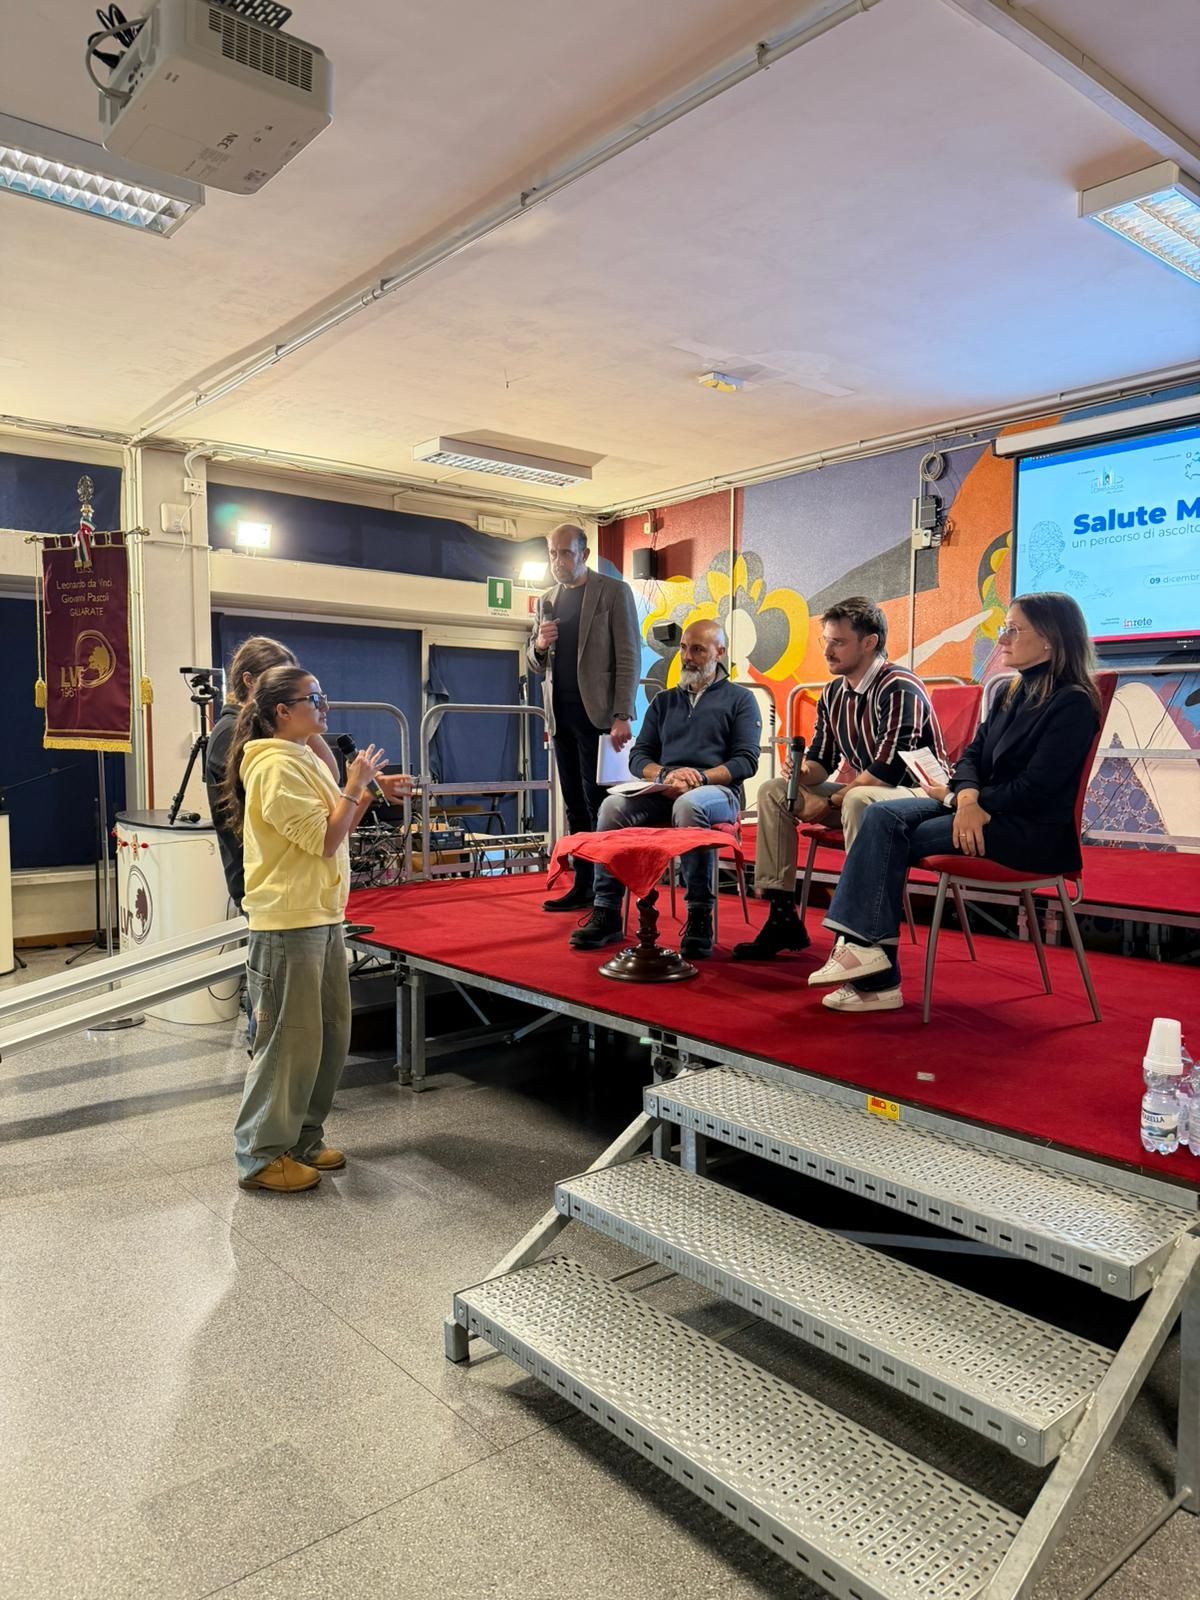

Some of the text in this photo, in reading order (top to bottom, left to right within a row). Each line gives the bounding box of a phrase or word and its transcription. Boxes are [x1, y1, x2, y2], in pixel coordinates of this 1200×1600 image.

[217, 132, 239, 150] NEC
[1073, 506, 1167, 535] Salute
[1071, 539, 1087, 549] un
[1090, 532, 1140, 548] percorso
[1143, 528, 1155, 540] di
[87, 578, 97, 588] da
[87, 592, 110, 602] Pascoli
